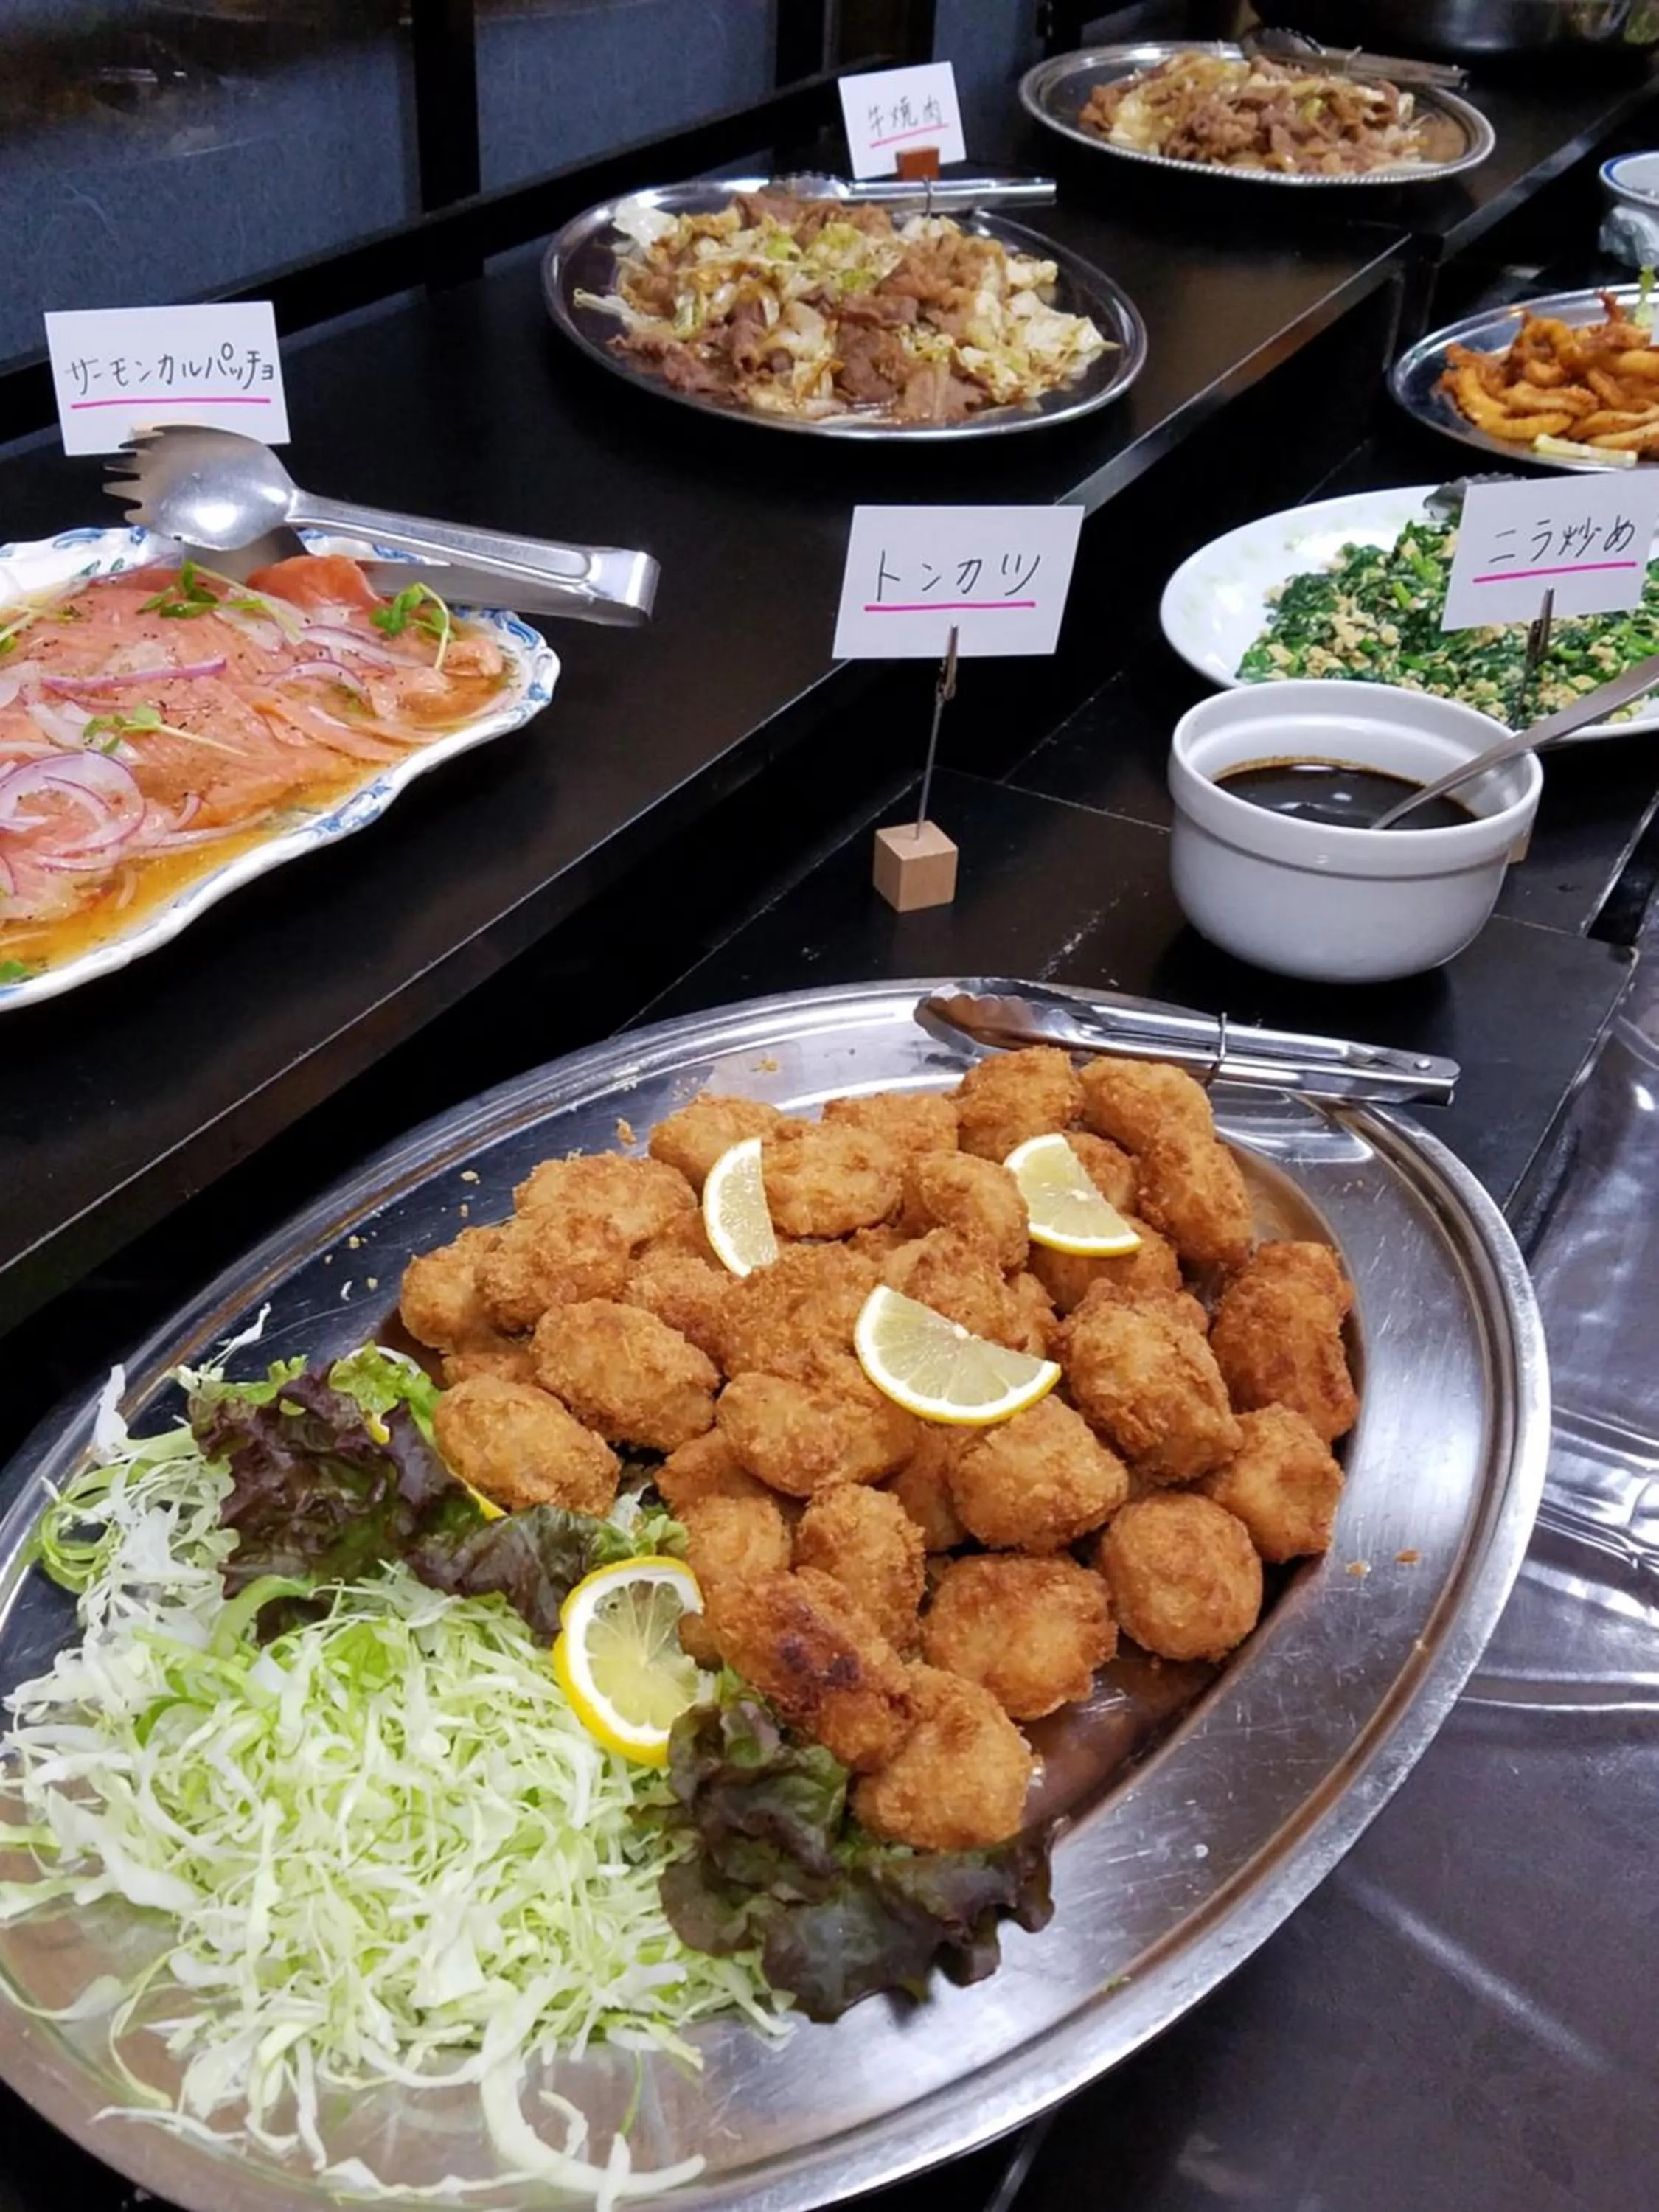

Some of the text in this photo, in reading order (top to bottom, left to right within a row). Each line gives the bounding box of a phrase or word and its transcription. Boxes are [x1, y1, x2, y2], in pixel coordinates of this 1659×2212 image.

[64, 341, 274, 396] サーモンカルパッチョ
[1488, 514, 1635, 563] ニラ炒め
[875, 549, 1041, 602] トンカツ
